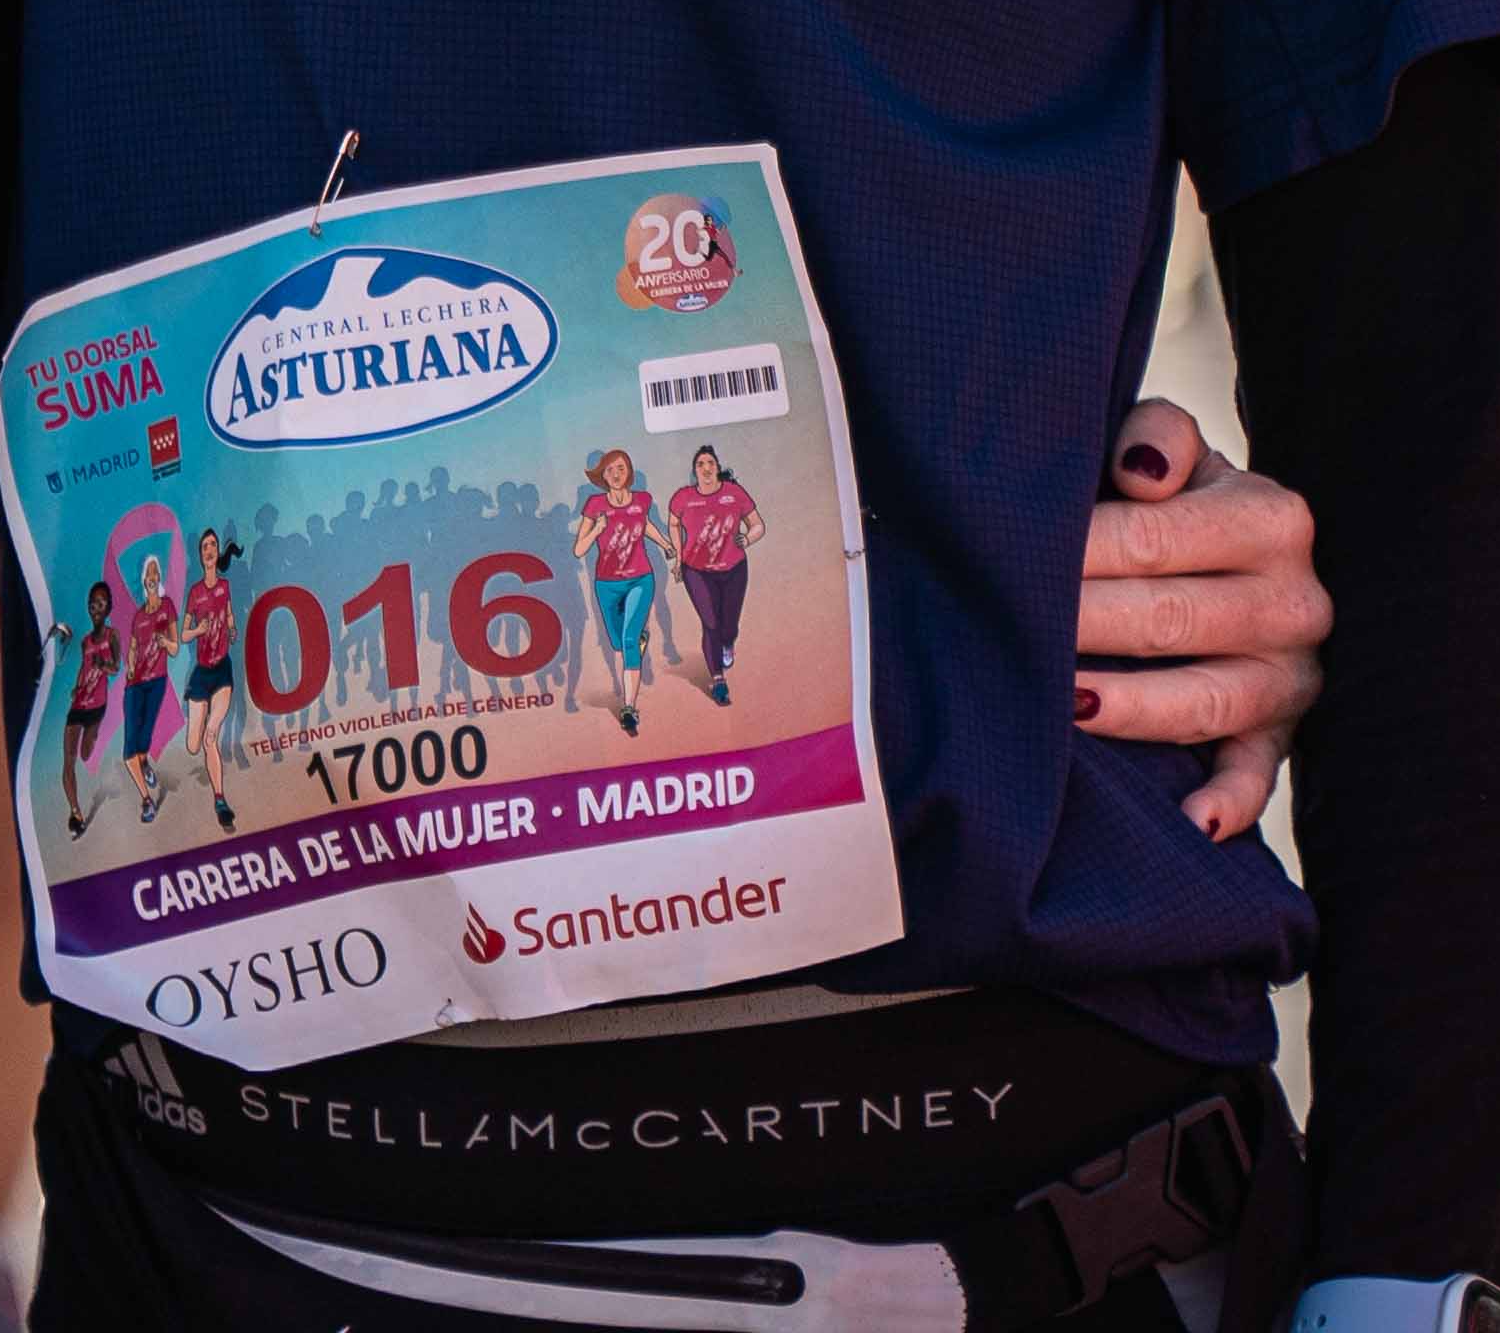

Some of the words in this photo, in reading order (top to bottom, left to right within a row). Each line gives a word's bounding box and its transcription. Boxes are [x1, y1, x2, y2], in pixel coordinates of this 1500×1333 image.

[640, 209, 711, 274] 20
[25, 356, 58, 388] TU
[64, 324, 158, 374] DORSAL
[261, 316, 370, 355] CENTRAL
[384, 295, 510, 329] LECHERA
[36, 356, 164, 431] SUMA
[226, 323, 531, 427] ASTURIANA
[72, 448, 140, 485] MADRID
[244, 551, 563, 715] 016
[250, 724, 336, 757] TELÉFONO
[340, 704, 437, 735] VIOLENCIA
[443, 700, 468, 717] DE
[472, 692, 555, 714] GÉNERO
[306, 724, 488, 805] 17000
[132, 847, 296, 922] CARRERA
[299, 830, 350, 878] DE
[351, 823, 395, 866] LA
[395, 796, 537, 858] MUJER
[577, 765, 754, 828] MADRID
[513, 876, 786, 957] Santander
[145, 927, 387, 1027] OYSHO
